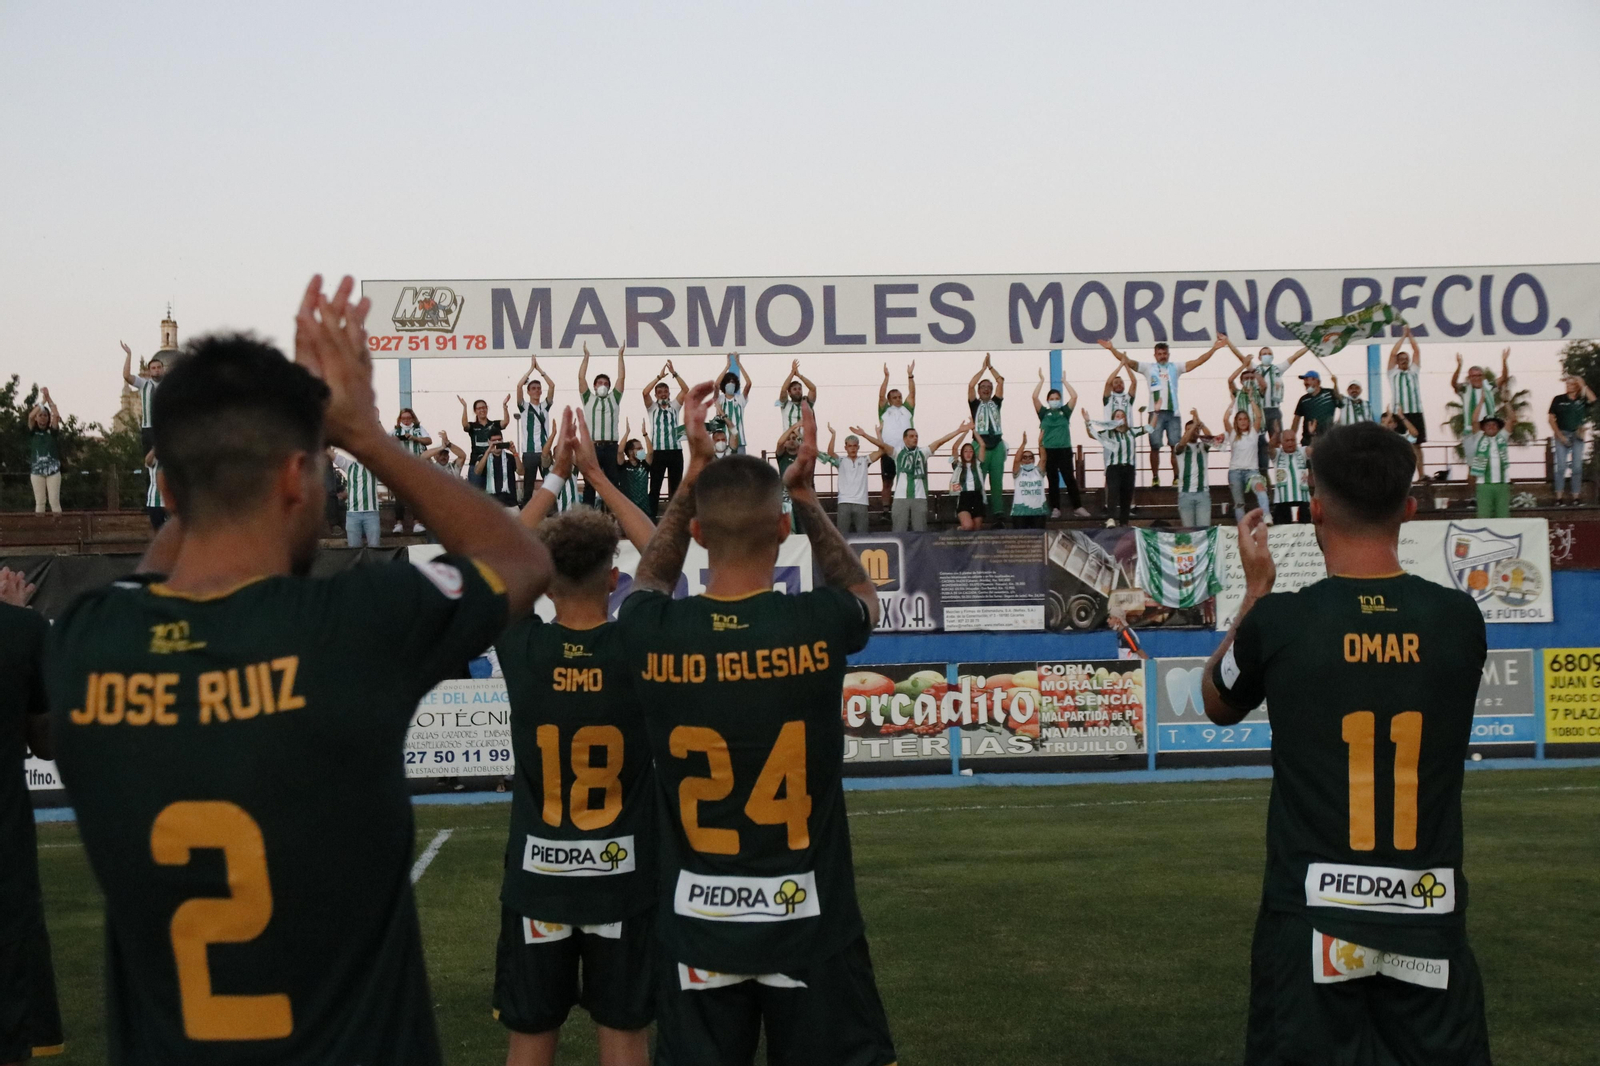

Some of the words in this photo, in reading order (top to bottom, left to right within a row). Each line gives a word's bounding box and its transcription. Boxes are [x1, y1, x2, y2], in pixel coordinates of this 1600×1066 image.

[491, 282, 977, 351] MARMOLES
[1008, 277, 1313, 344] MORENO
[368, 336, 404, 351] 927
[408, 336, 429, 351] 51
[436, 335, 457, 350] 91
[463, 335, 487, 350] 78
[1268, 540, 1319, 549] rometido
[1277, 570, 1318, 578] camino
[1497, 607, 1545, 619] FÚTBOL
[1344, 633, 1420, 663] OMAR
[641, 652, 707, 684] JULIO
[716, 641, 830, 682] IGLESIAS
[1041, 664, 1095, 676] CORIA
[552, 667, 603, 692] SIMO
[1481, 659, 1518, 685] ME
[434, 683, 490, 691] ECONOCIMIENTO
[1041, 678, 1136, 691] MORALEJA
[1550, 676, 1586, 689] JUAN
[70, 672, 181, 727] JOSE
[199, 655, 306, 725] RUIZ
[420, 692, 437, 706] LE
[443, 692, 468, 705] DEL
[472, 691, 511, 704] ALAG
[1550, 693, 1588, 702] PAGOS
[847, 674, 1036, 728] ercadito
[1042, 694, 1140, 706] PLASENCIA
[1475, 697, 1503, 706] rez
[408, 709, 509, 729] OTÉCNI
[1042, 710, 1109, 722] MALPARTIDA
[1112, 712, 1123, 720] DE
[1551, 708, 1559, 720] 7
[1564, 708, 1600, 720] PLAZ
[484, 729, 512, 738] EMBAR
[1042, 726, 1138, 738] NAVALMORAL
[1168, 729, 1186, 743] T.
[1202, 728, 1252, 742] 927
[465, 739, 510, 748] SEGURIDAD
[843, 736, 1034, 760] UTERIAS
[1042, 740, 1128, 753] TRUJILLO
[402, 751, 427, 764] 27
[434, 750, 455, 763] 50
[462, 750, 481, 762] 11
[489, 748, 510, 761] 99
[416, 766, 449, 774] ESTACIÓN
[463, 765, 504, 773] AUTOBUSES
[536, 723, 624, 832] 18
[1341, 710, 1423, 851] 11
[669, 719, 812, 855] 24
[150, 800, 293, 1041] 2
[1382, 953, 1442, 974] Córdoba
